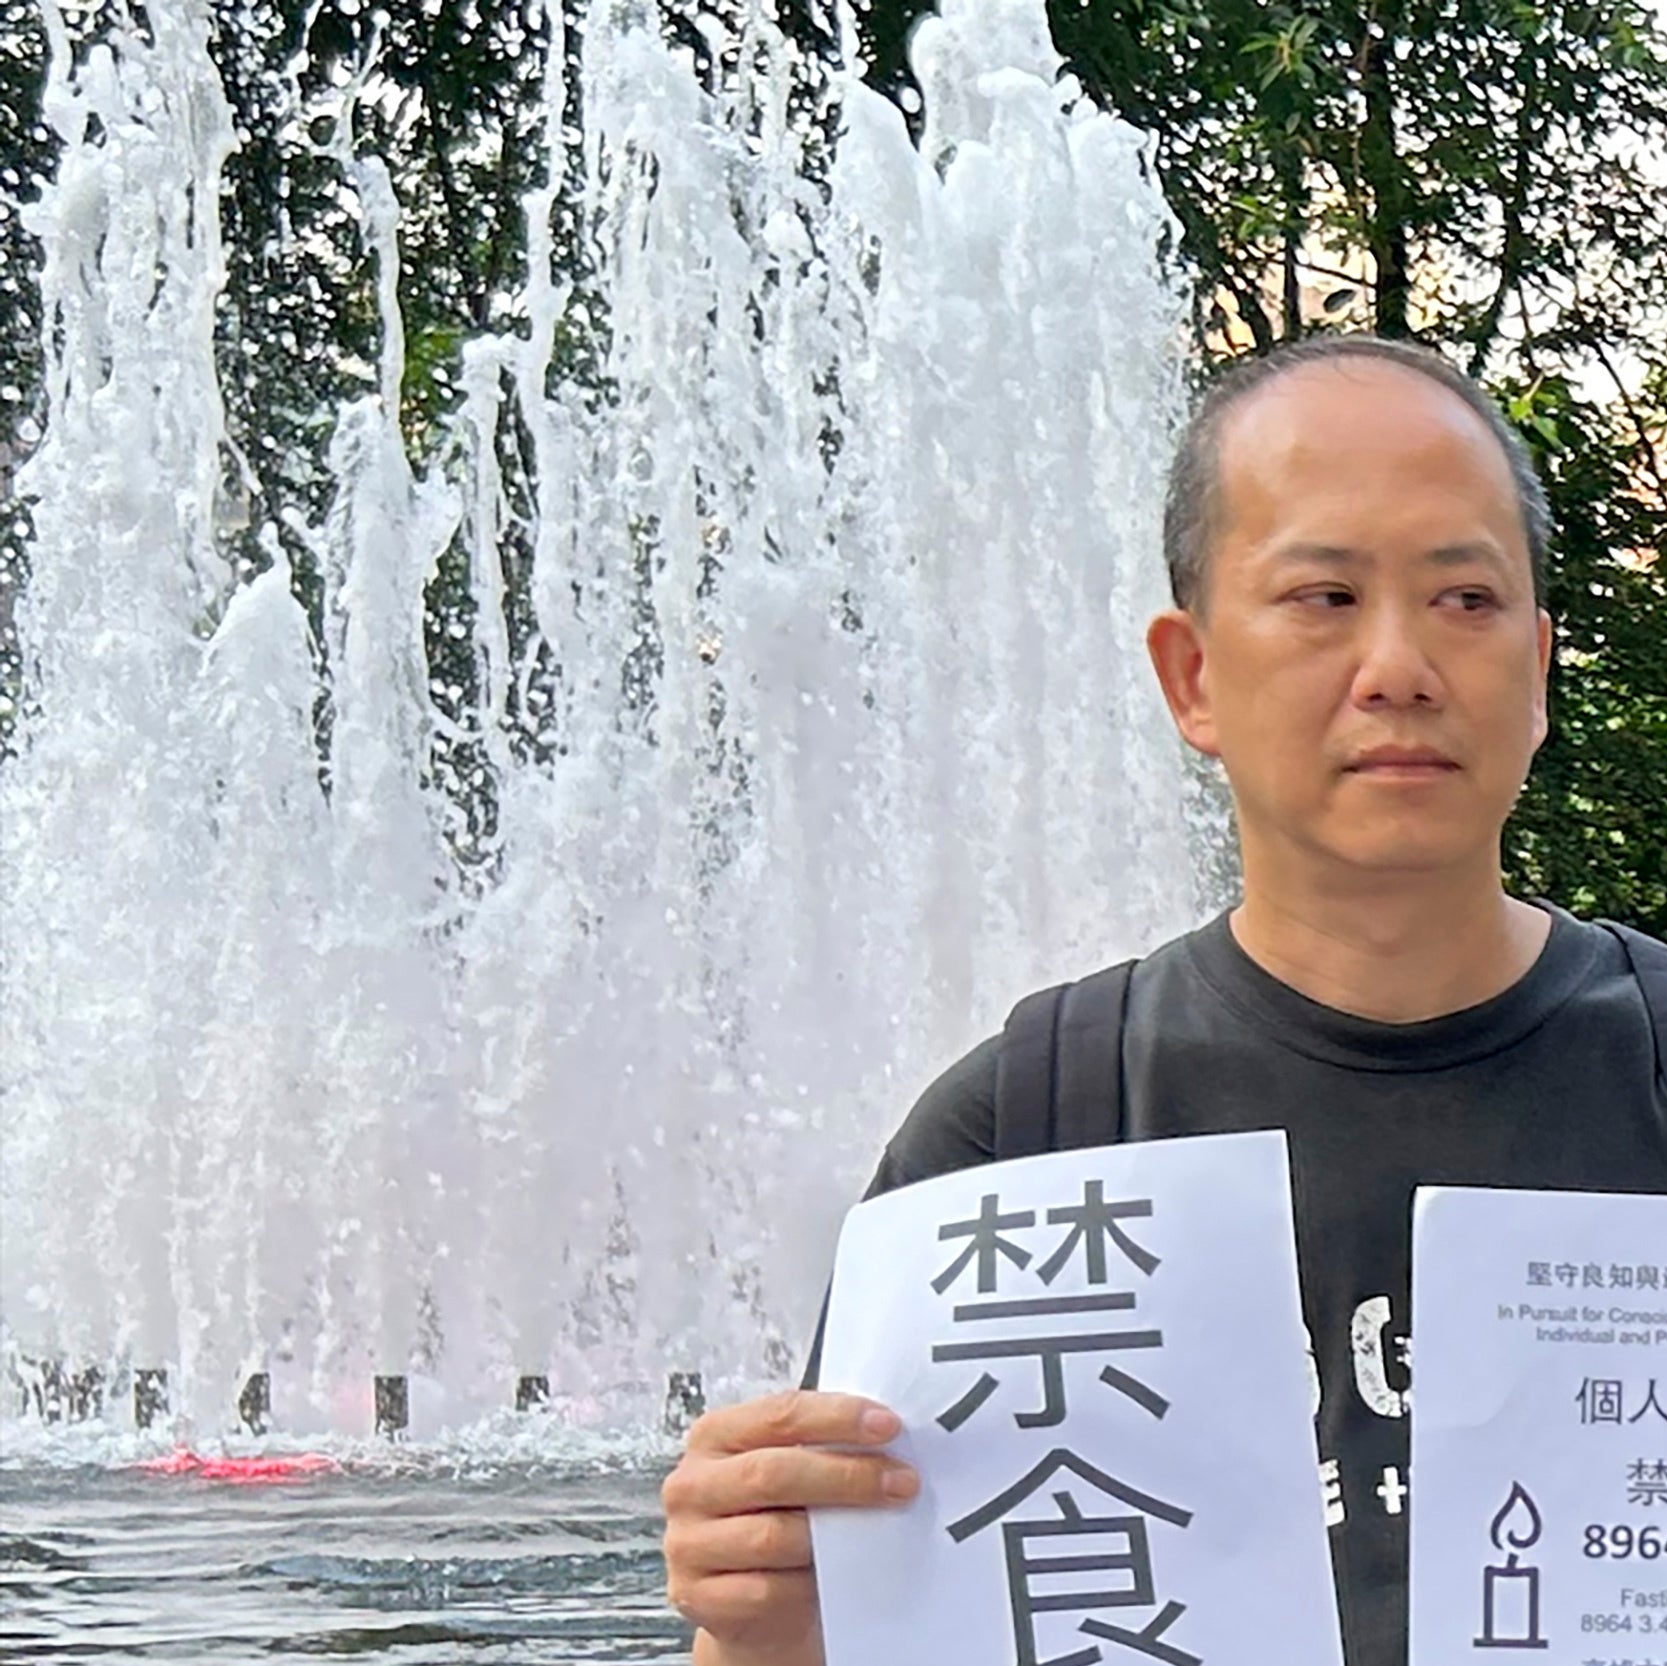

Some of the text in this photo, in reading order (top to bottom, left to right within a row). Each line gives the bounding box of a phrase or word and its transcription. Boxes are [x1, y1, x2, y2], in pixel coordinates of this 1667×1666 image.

[1498, 1305, 1512, 1319] In
[1519, 1305, 1577, 1322] Pursuit
[1582, 1306, 1602, 1322] for
[1536, 1327, 1614, 1343] Individual
[1620, 1329, 1649, 1344] and
[1581, 1614, 1632, 1632] 8964
